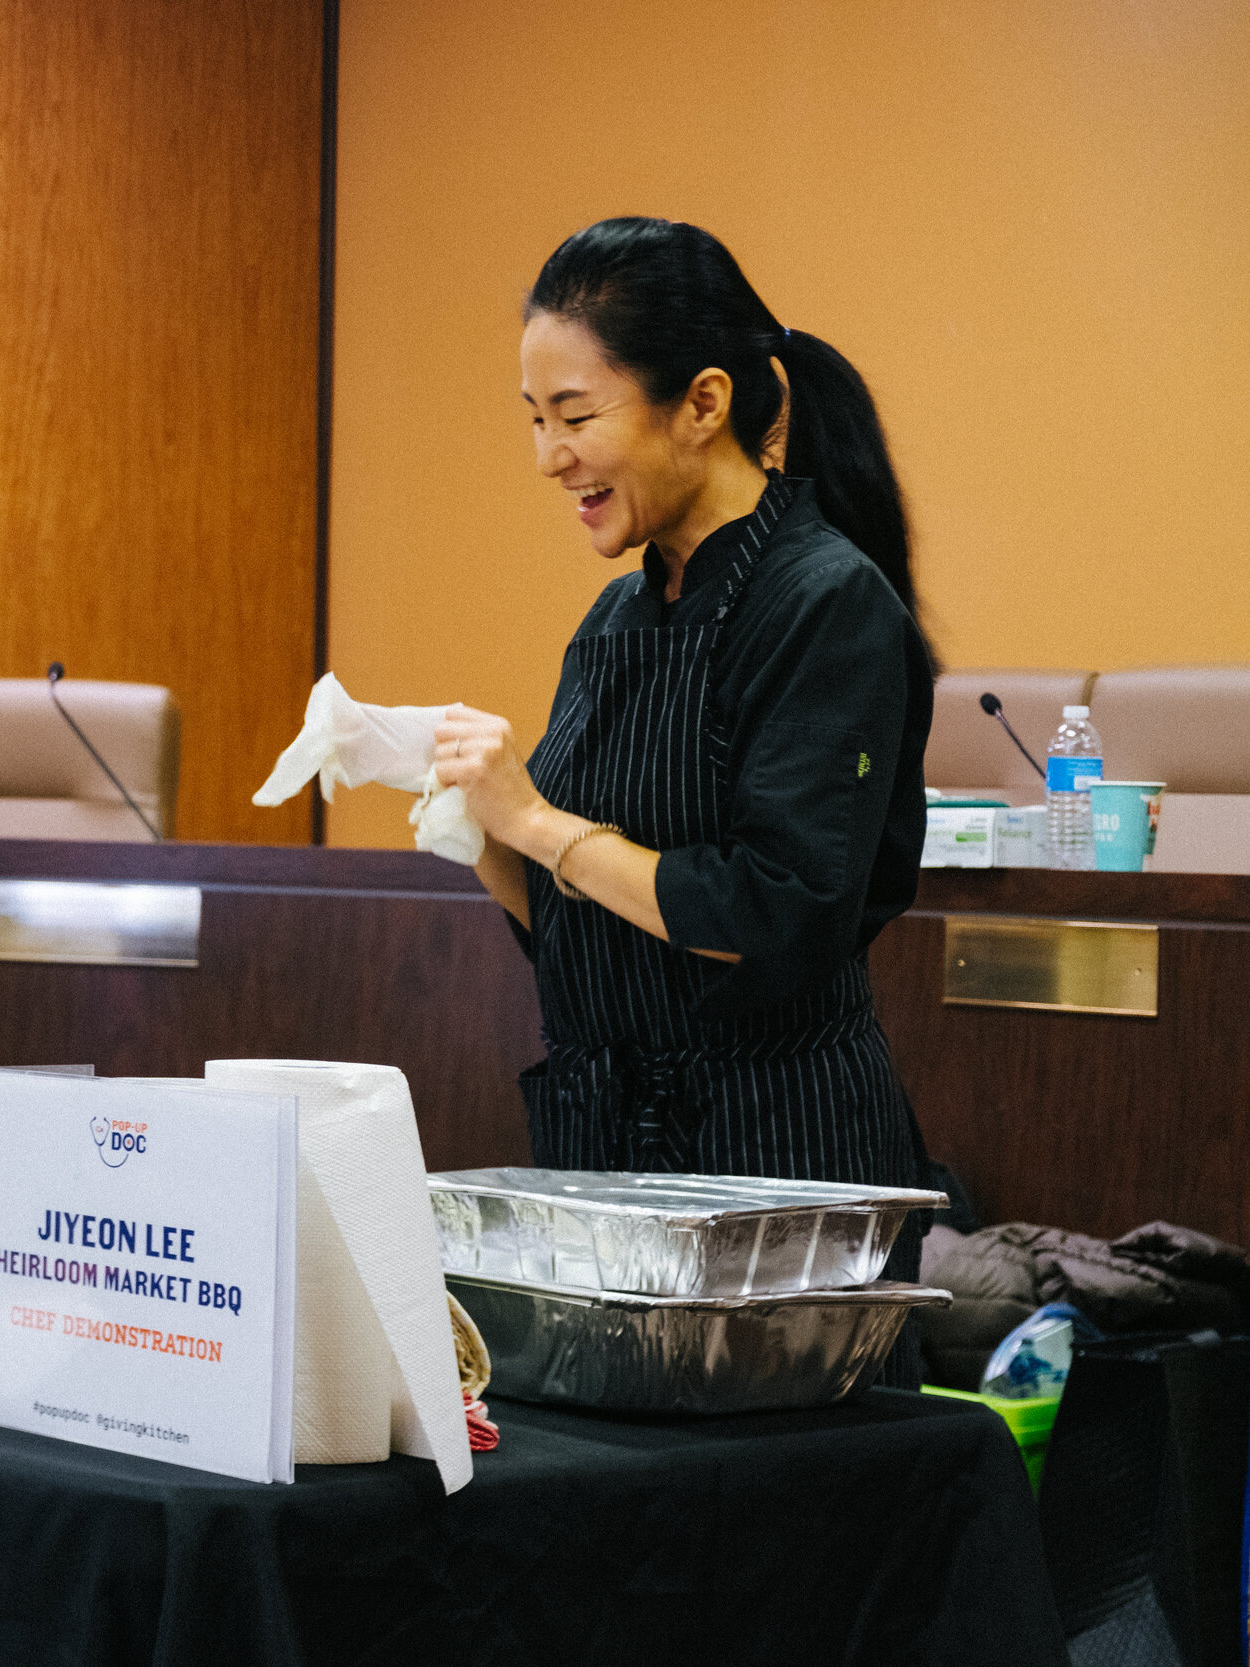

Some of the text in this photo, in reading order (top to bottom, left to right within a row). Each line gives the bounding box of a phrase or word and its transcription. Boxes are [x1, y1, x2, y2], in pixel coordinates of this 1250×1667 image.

[111, 1119, 148, 1133] POP-UP
[111, 1131, 146, 1153] DOC
[37, 1209, 196, 1263] JIYEON LEE
[104, 1265, 192, 1303] MARKET
[198, 1280, 242, 1316] BBQ
[9, 1305, 224, 1363] CHEF DEMONSTRATION
[33, 1400, 190, 1444] #popupdoc @givingkitchen
